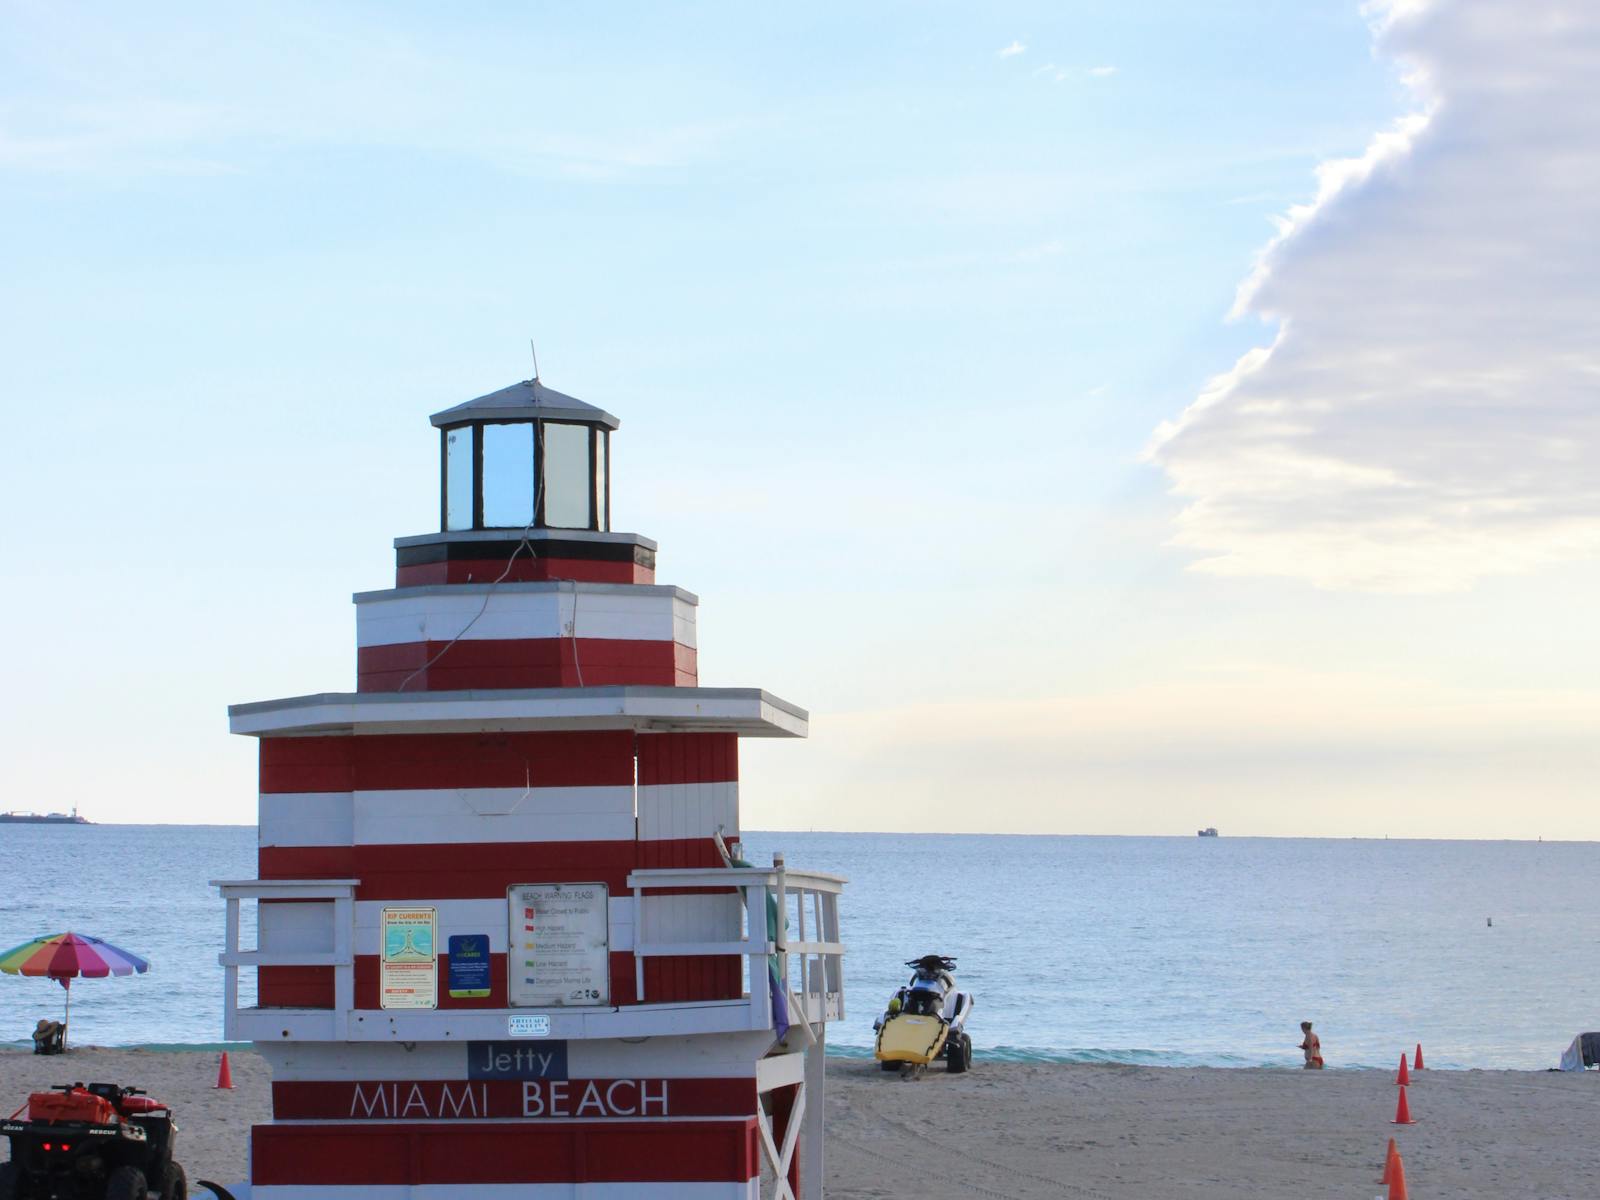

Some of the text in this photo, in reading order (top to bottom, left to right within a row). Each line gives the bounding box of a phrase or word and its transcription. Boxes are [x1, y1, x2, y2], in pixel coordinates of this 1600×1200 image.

[575, 891, 593, 899] FLAGS
[482, 1045, 554, 1075] Jetty
[350, 1079, 668, 1118] MIAMI BEACH
